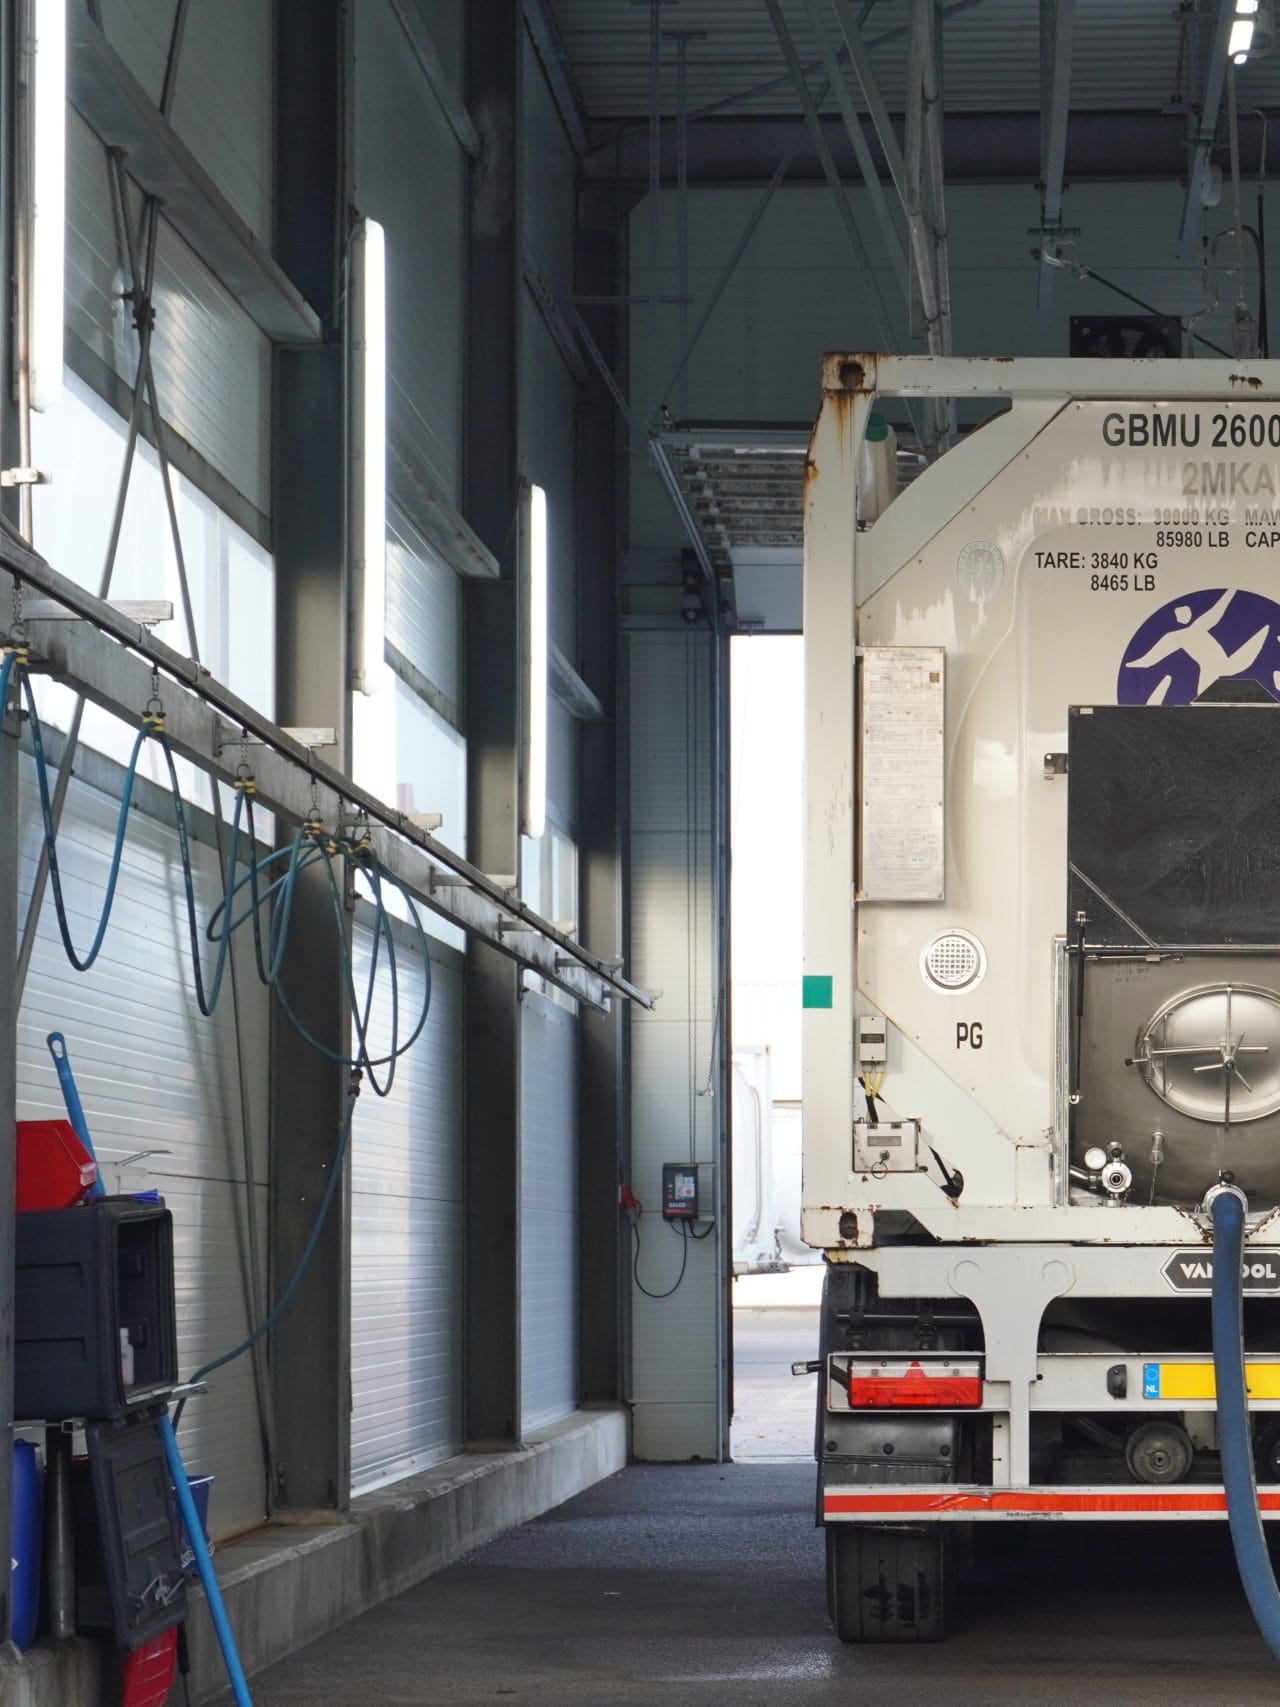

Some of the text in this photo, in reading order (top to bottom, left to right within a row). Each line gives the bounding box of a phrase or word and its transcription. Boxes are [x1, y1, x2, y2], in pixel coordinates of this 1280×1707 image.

[1103, 412, 1201, 448] GBMU
[1182, 462, 1276, 497] 2MKA
[1076, 507, 1142, 525] GROSS:
[1204, 508, 1230, 525] KG
[1156, 531, 1230, 548] 85980 LB
[1034, 552, 1158, 569] TARE: 3840 KG
[1090, 575, 1156, 592] 8465 LB
[956, 1022, 983, 1050] PG
[1145, 1385, 1159, 1393] NL
